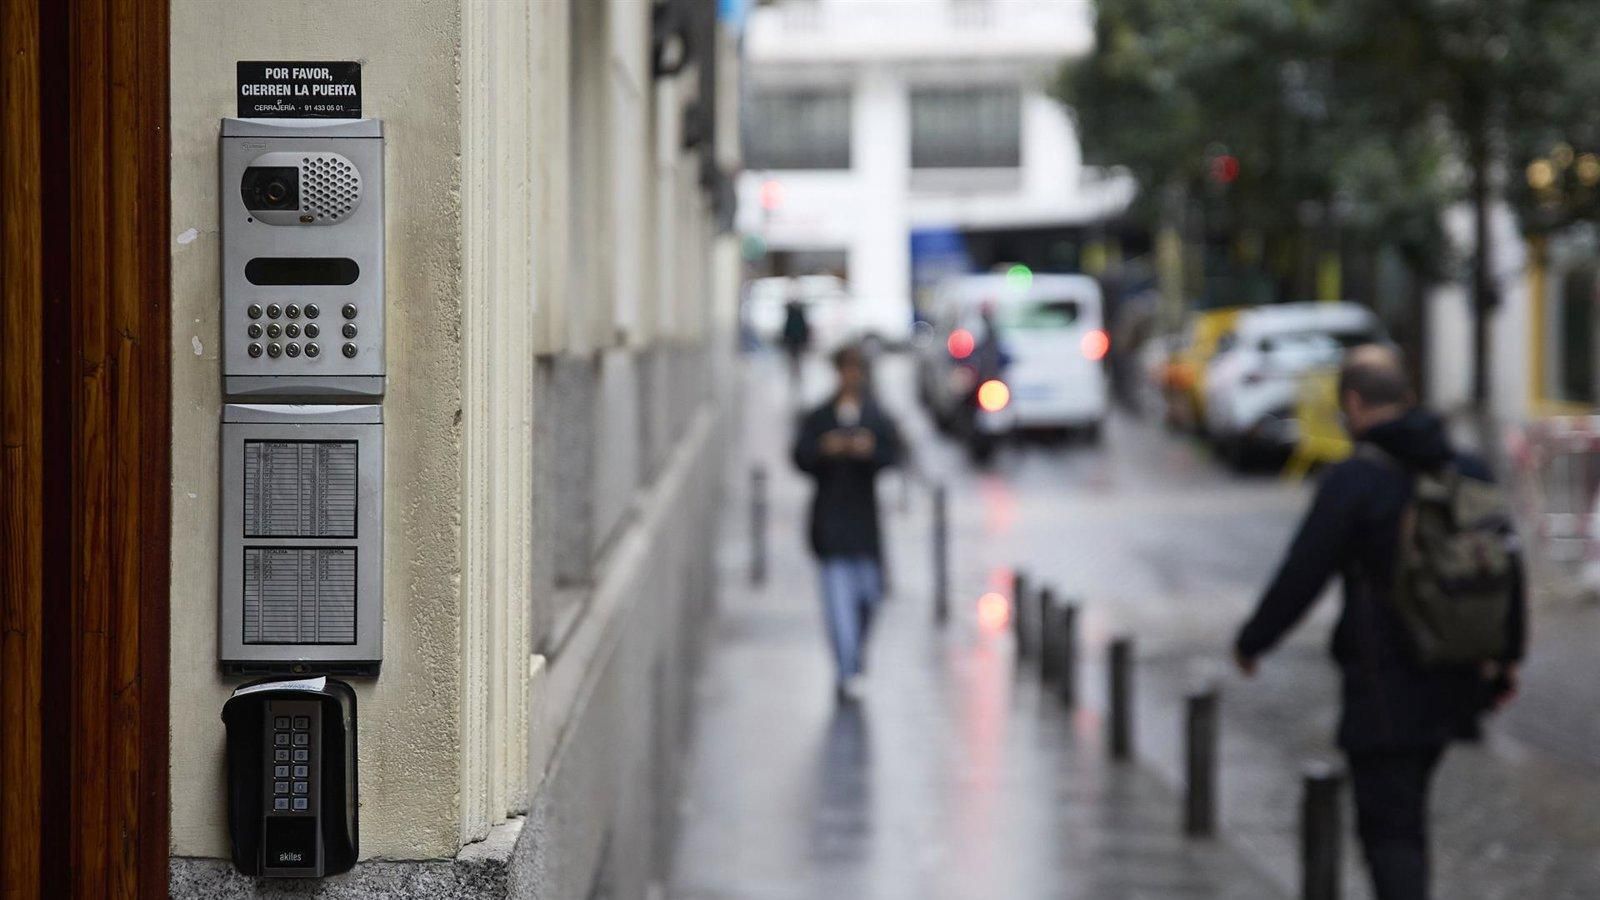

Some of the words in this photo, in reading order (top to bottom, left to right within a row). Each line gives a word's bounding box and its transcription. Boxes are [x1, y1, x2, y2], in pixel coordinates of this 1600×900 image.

[265, 68, 289, 79] POR
[292, 68, 333, 81] FAVOR,
[241, 84, 291, 96] CIERREN
[294, 84, 310, 96] LA
[312, 84, 357, 96] PUERTA
[254, 103, 296, 111] CERRAJERÍA
[279, 851, 302, 862] akiles
